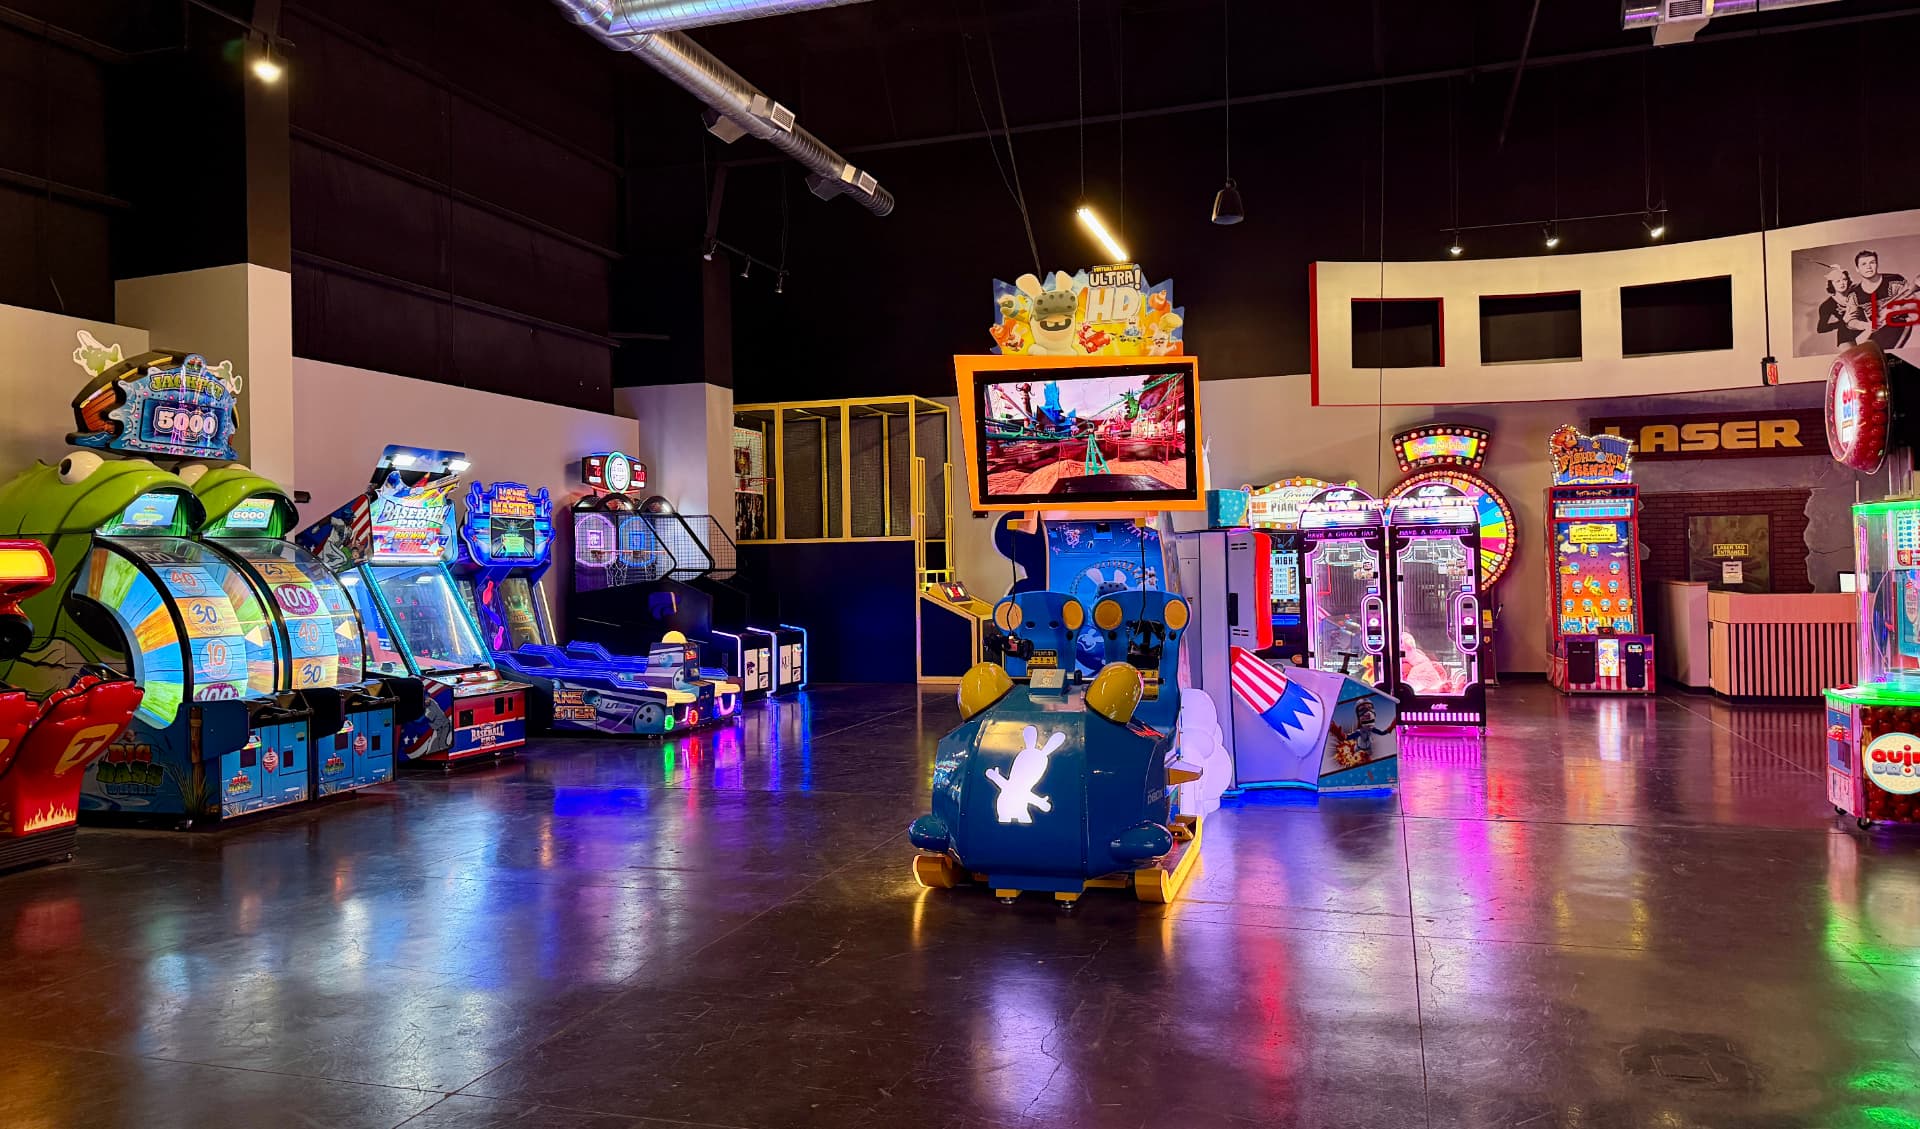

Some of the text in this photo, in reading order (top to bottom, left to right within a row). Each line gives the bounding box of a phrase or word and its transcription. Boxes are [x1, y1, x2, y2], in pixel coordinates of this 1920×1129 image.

[1089, 268, 1141, 290] ULTRA!
[1086, 287, 1140, 323] HD
[150, 374, 224, 400] JACKPOT
[157, 410, 216, 434] 5000
[1568, 463, 1617, 477] FRENZY
[498, 487, 528, 501] LANE
[232, 511, 265, 520] 5000
[377, 500, 451, 525] BASEBALL
[492, 501, 536, 517] MASTER
[397, 518, 427, 529] PRO
[170, 570, 197, 587] 40
[277, 587, 311, 608] 100
[191, 603, 218, 624] 30
[299, 621, 319, 642] 40
[207, 643, 226, 667] 10
[303, 663, 322, 684] 30
[554, 690, 584, 705] ANE
[554, 705, 597, 720] STER
[471, 725, 505, 742] BASEBALL
